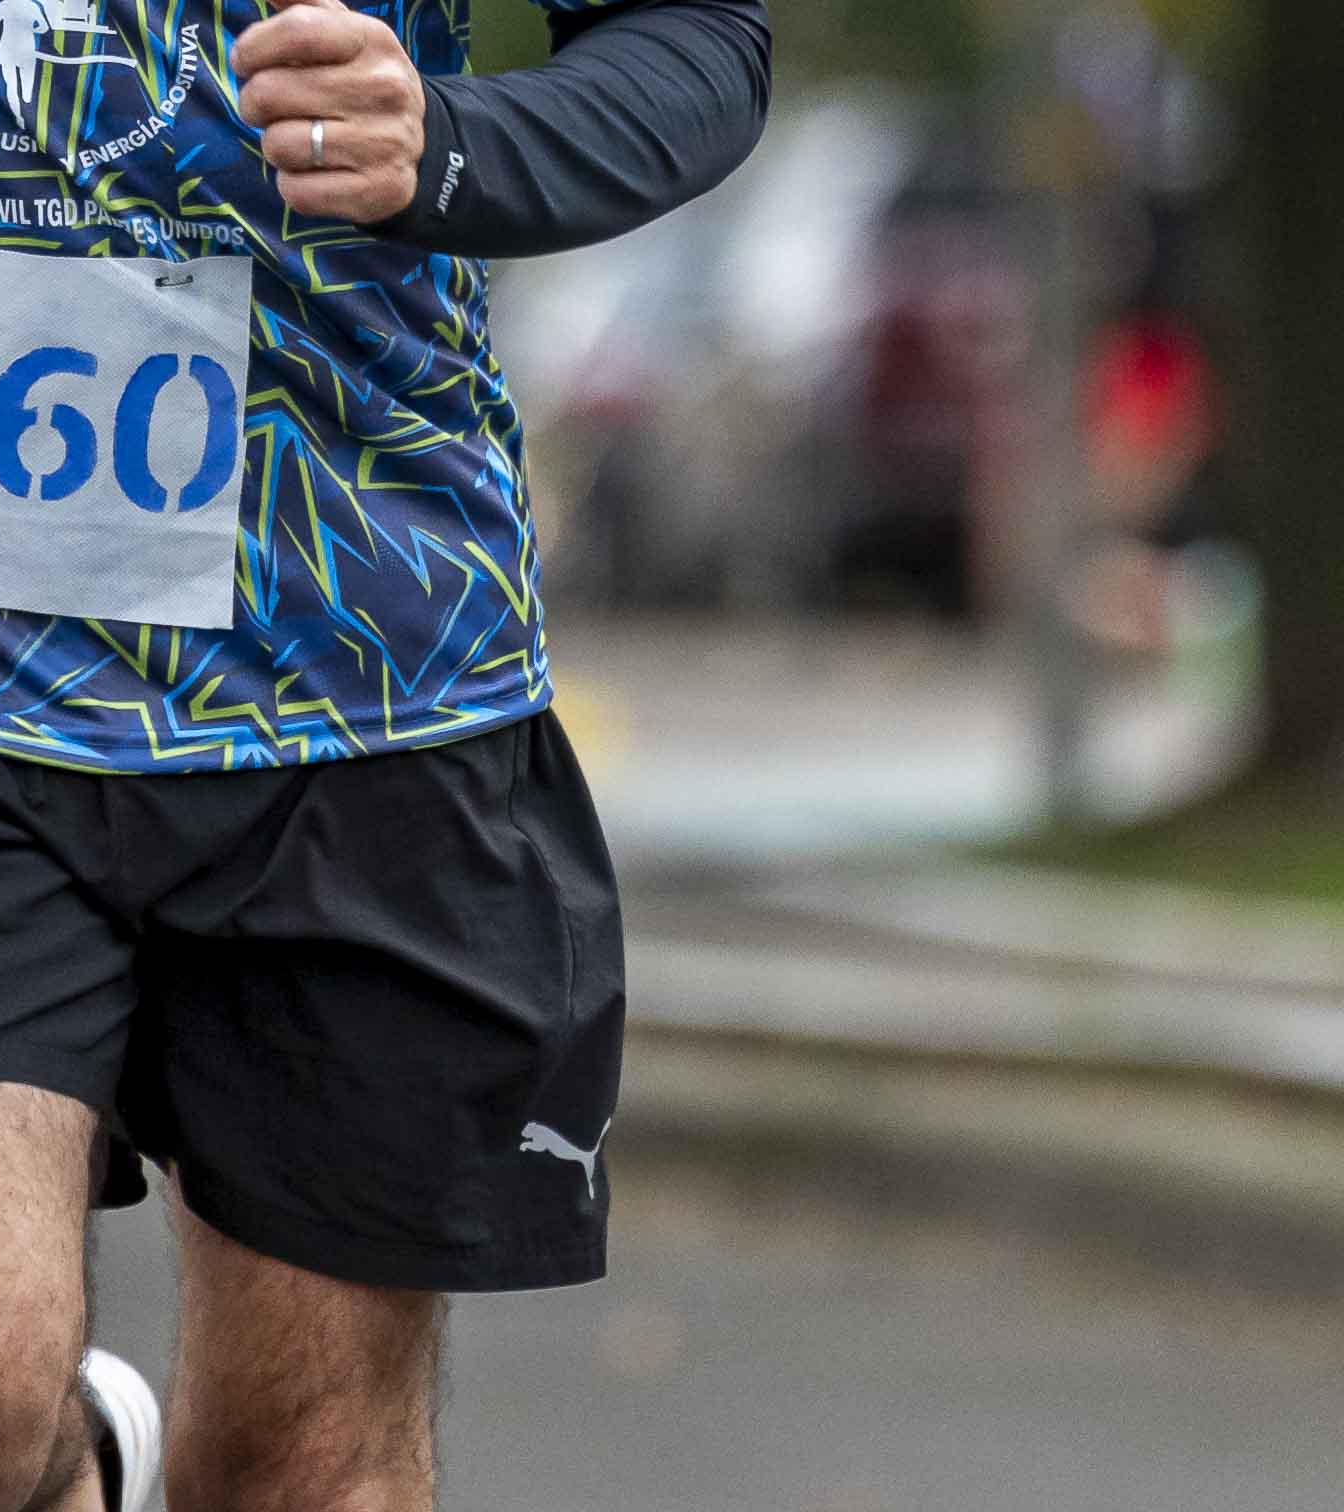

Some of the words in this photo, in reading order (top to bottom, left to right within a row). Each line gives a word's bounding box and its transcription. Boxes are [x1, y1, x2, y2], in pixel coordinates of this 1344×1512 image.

[78, 115, 169, 169] ENERGÍA
[159, 23, 200, 118] POSITIVA
[34, 197, 78, 227] TGD
[159, 216, 245, 246] UNIDOS
